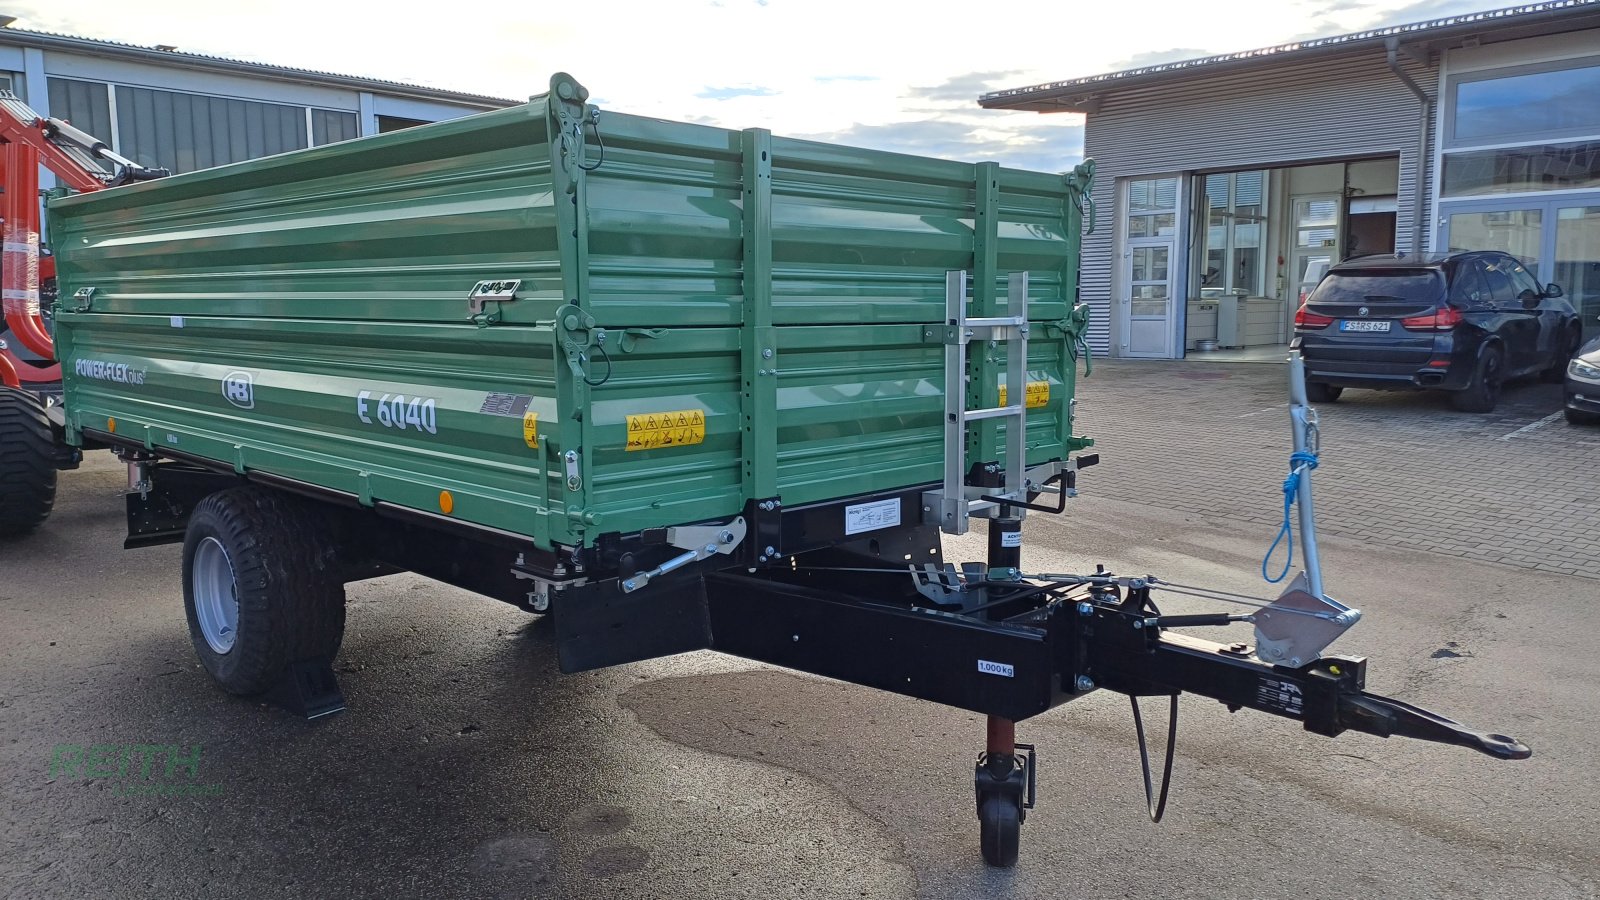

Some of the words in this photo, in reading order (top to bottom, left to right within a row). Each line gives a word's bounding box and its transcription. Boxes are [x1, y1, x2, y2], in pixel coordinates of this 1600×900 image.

[1344, 321, 1356, 330] FS
[1360, 322, 1372, 330] RS
[1373, 322, 1388, 331] 621
[75, 358, 129, 384] POWER-FLEX
[357, 390, 373, 424] E
[377, 393, 437, 435] 6040
[979, 662, 1001, 673] 1.000
[1002, 666, 1013, 677] kg
